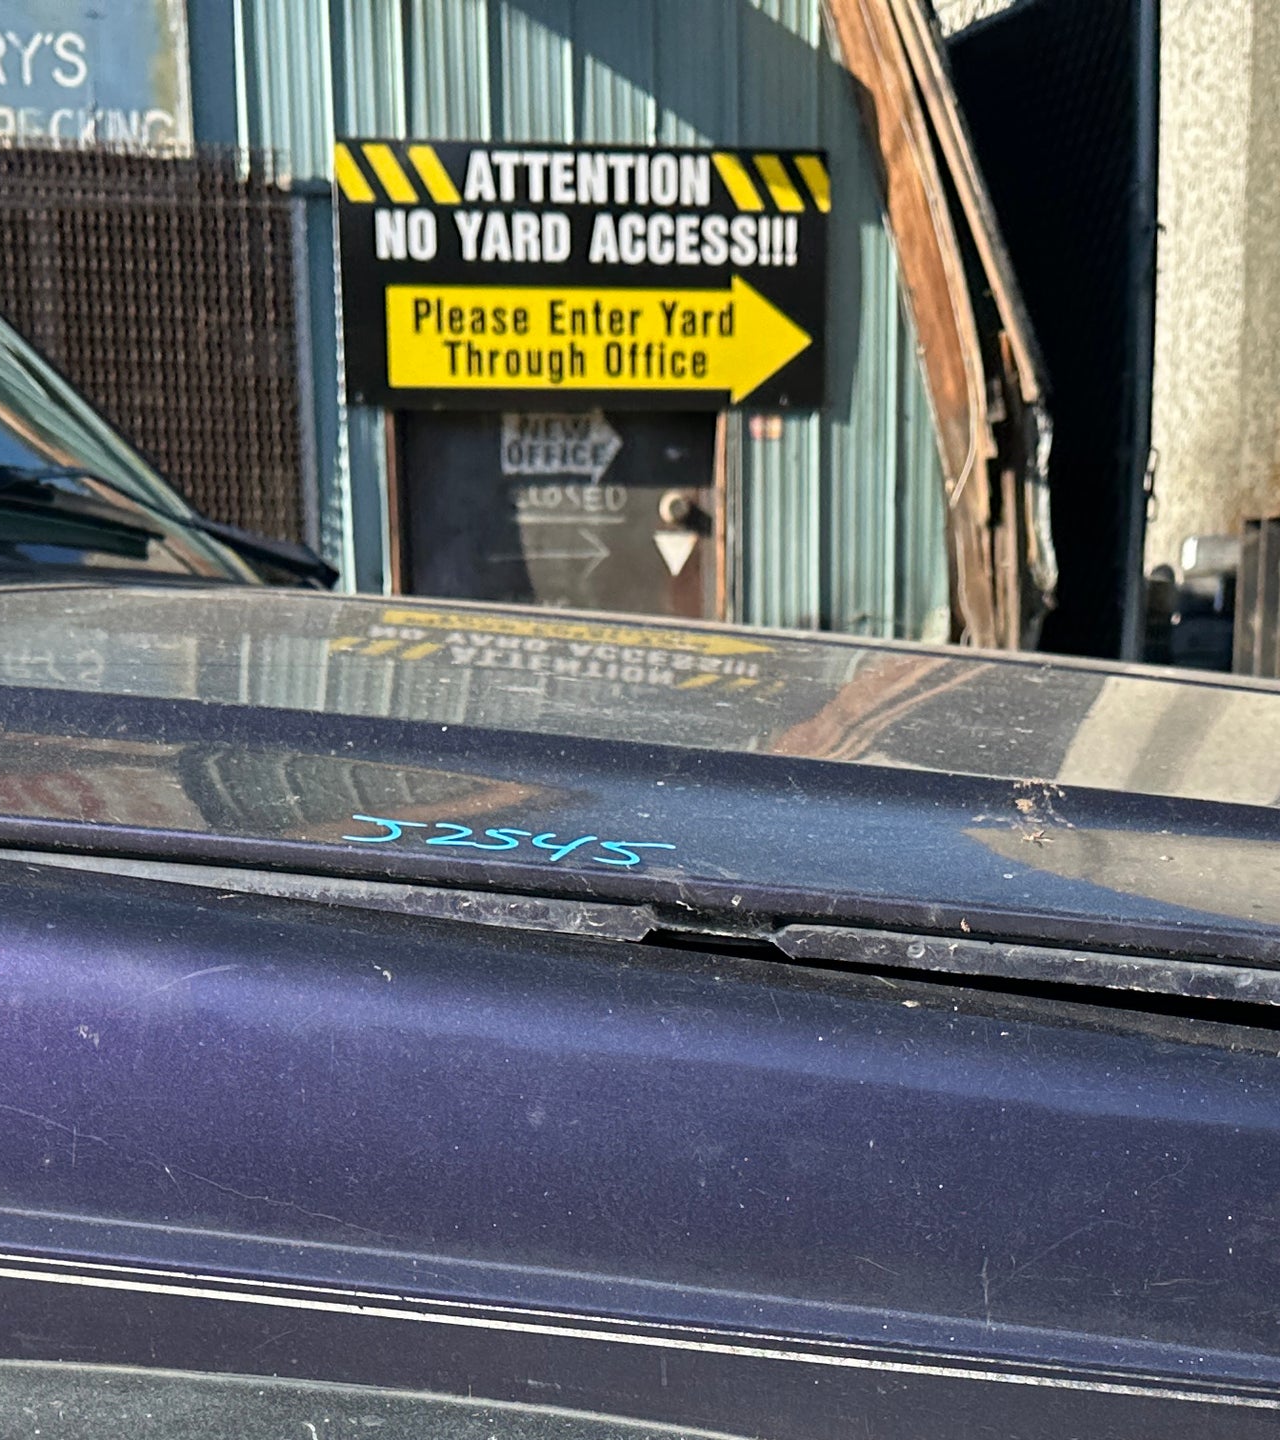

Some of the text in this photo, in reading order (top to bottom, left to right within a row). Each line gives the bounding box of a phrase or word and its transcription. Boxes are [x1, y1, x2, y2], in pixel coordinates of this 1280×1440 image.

[463, 150, 712, 206] ATTENTION
[375, 208, 799, 267] NO YARD ACCESS!!!
[412, 298, 735, 338] Please Enter Yard
[443, 340, 708, 384] Through Office
[507, 440, 610, 466] OFFICE
